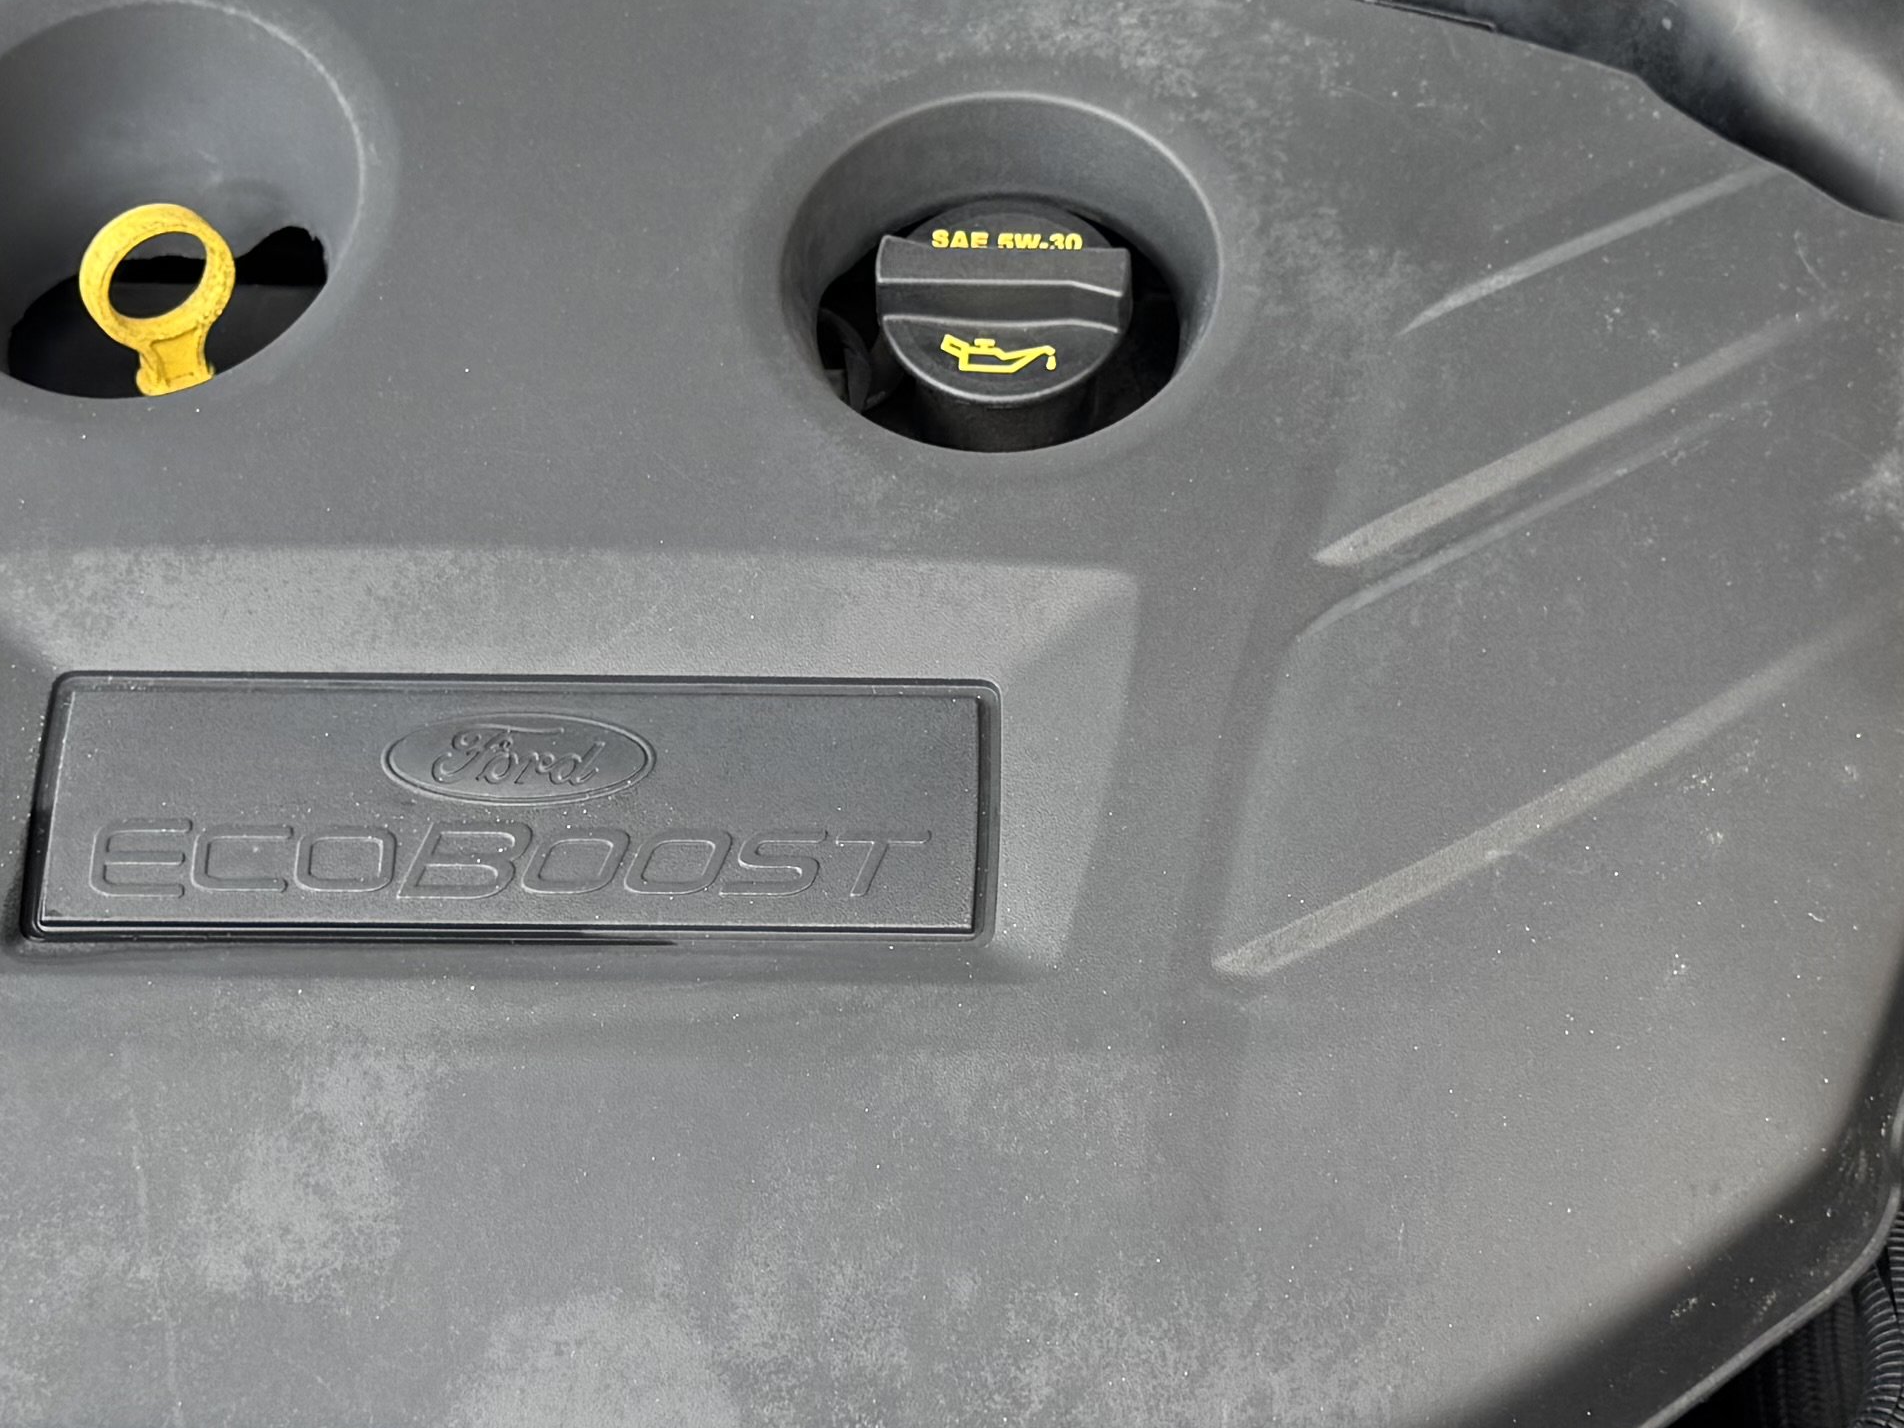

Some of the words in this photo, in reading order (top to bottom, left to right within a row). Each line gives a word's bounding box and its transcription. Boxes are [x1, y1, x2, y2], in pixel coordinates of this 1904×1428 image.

[931, 228, 990, 249] SAE
[997, 232, 1084, 251] 5W-30
[431, 722, 607, 790] Ford
